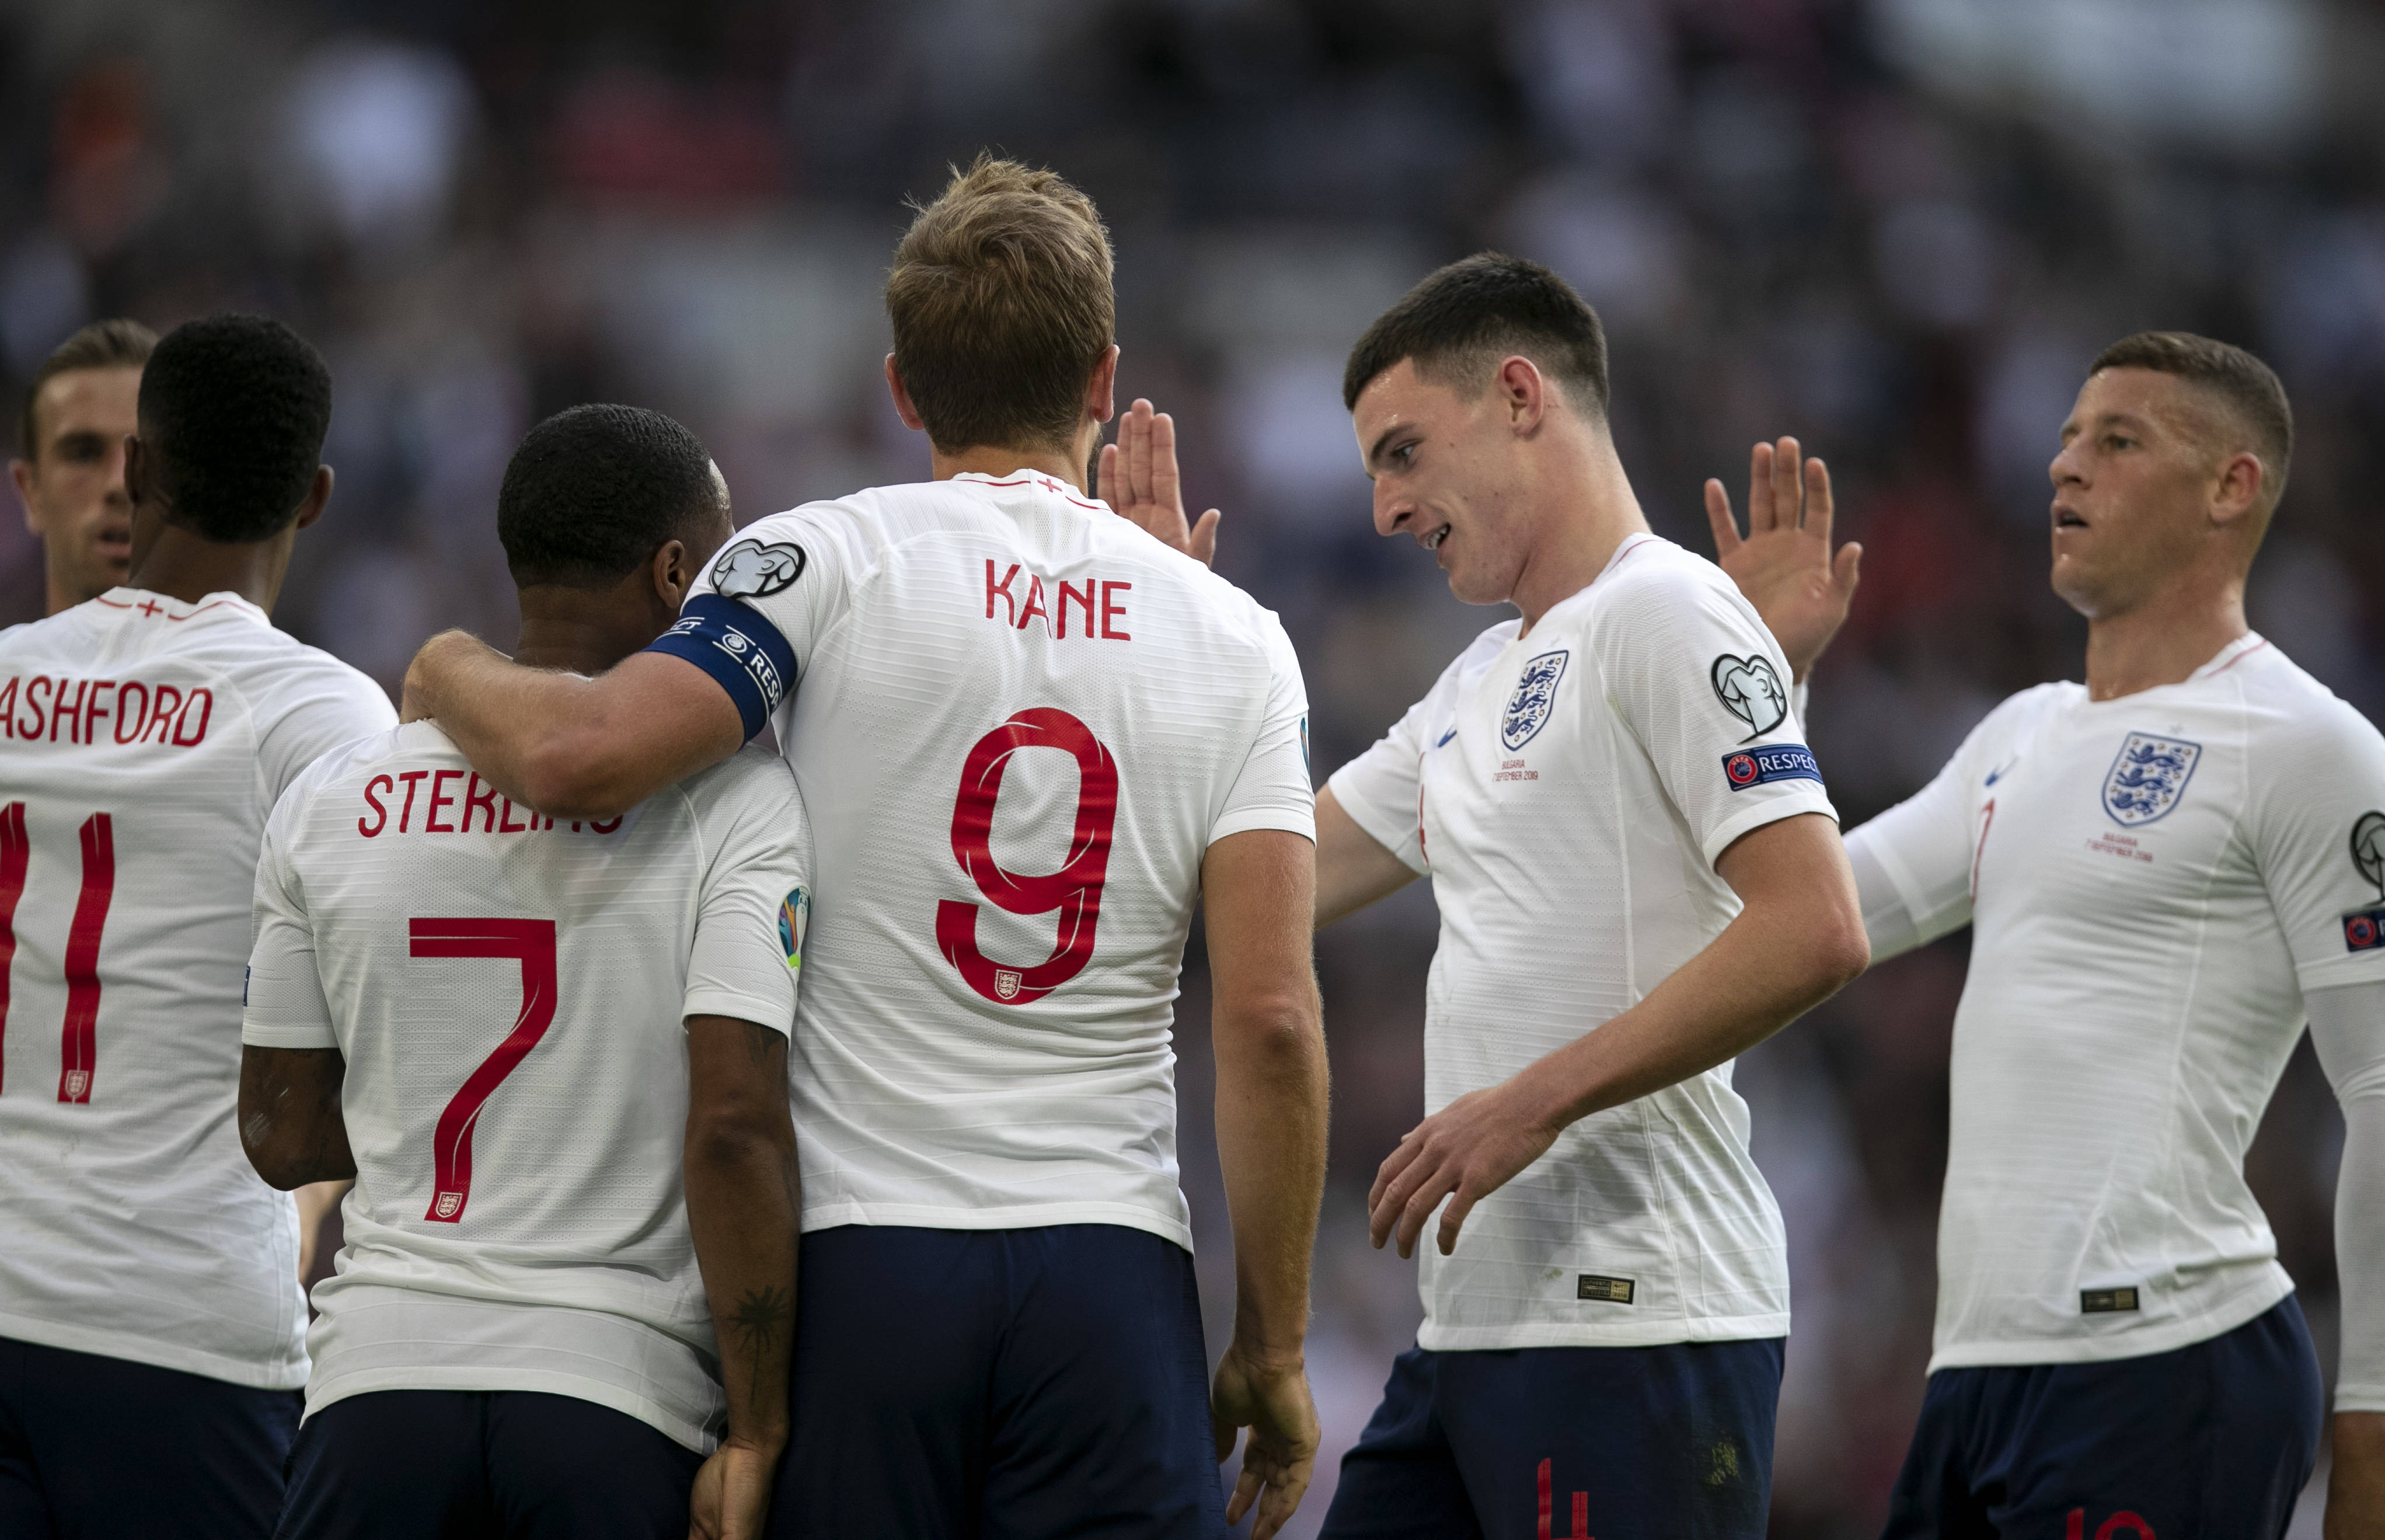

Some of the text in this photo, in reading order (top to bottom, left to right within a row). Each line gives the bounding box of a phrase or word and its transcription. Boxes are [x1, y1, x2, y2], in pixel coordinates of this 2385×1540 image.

[985, 559, 1132, 641] KANE
[750, 654, 780, 713] RESP
[358, 770, 623, 837] STERL
[1523, 770, 1539, 780] 2019
[936, 707, 1118, 1005] 9
[409, 917, 557, 1223] 7
